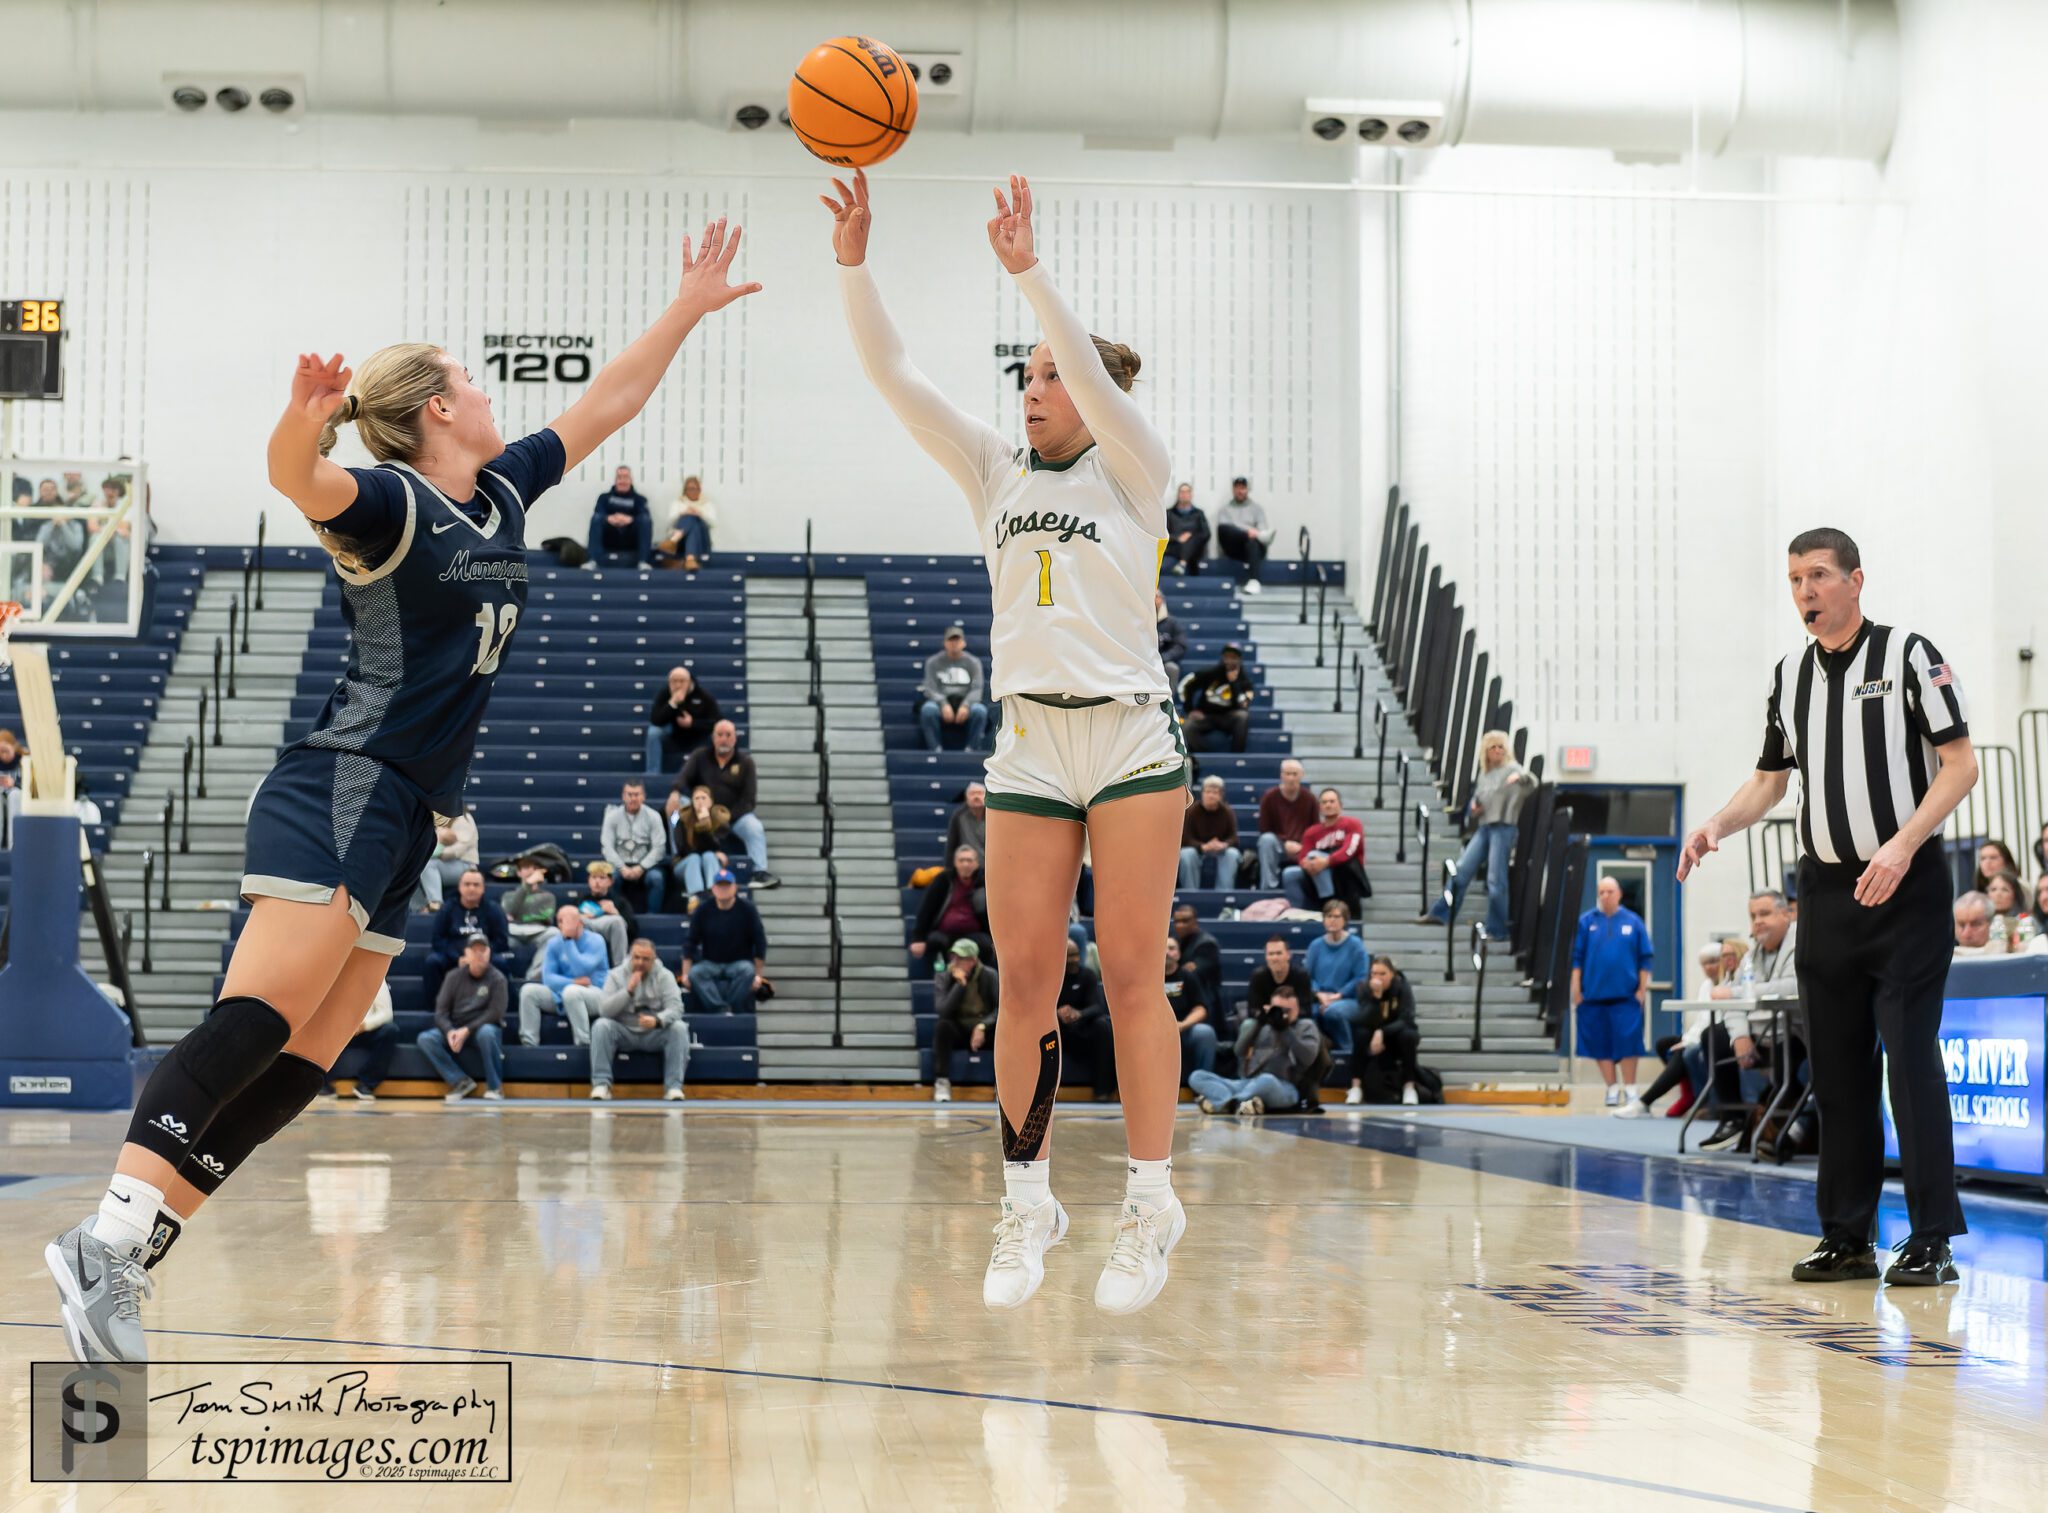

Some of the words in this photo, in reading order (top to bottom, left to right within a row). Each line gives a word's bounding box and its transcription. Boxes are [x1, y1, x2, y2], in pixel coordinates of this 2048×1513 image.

[21, 301, 60, 332] 36
[484, 335, 593, 349] SECTION
[486, 353, 591, 383] 120
[1035, 550, 1054, 606] 1
[1966, 1038, 2030, 1088] RIVER
[1972, 1094, 2030, 1129] SCHOOLS
